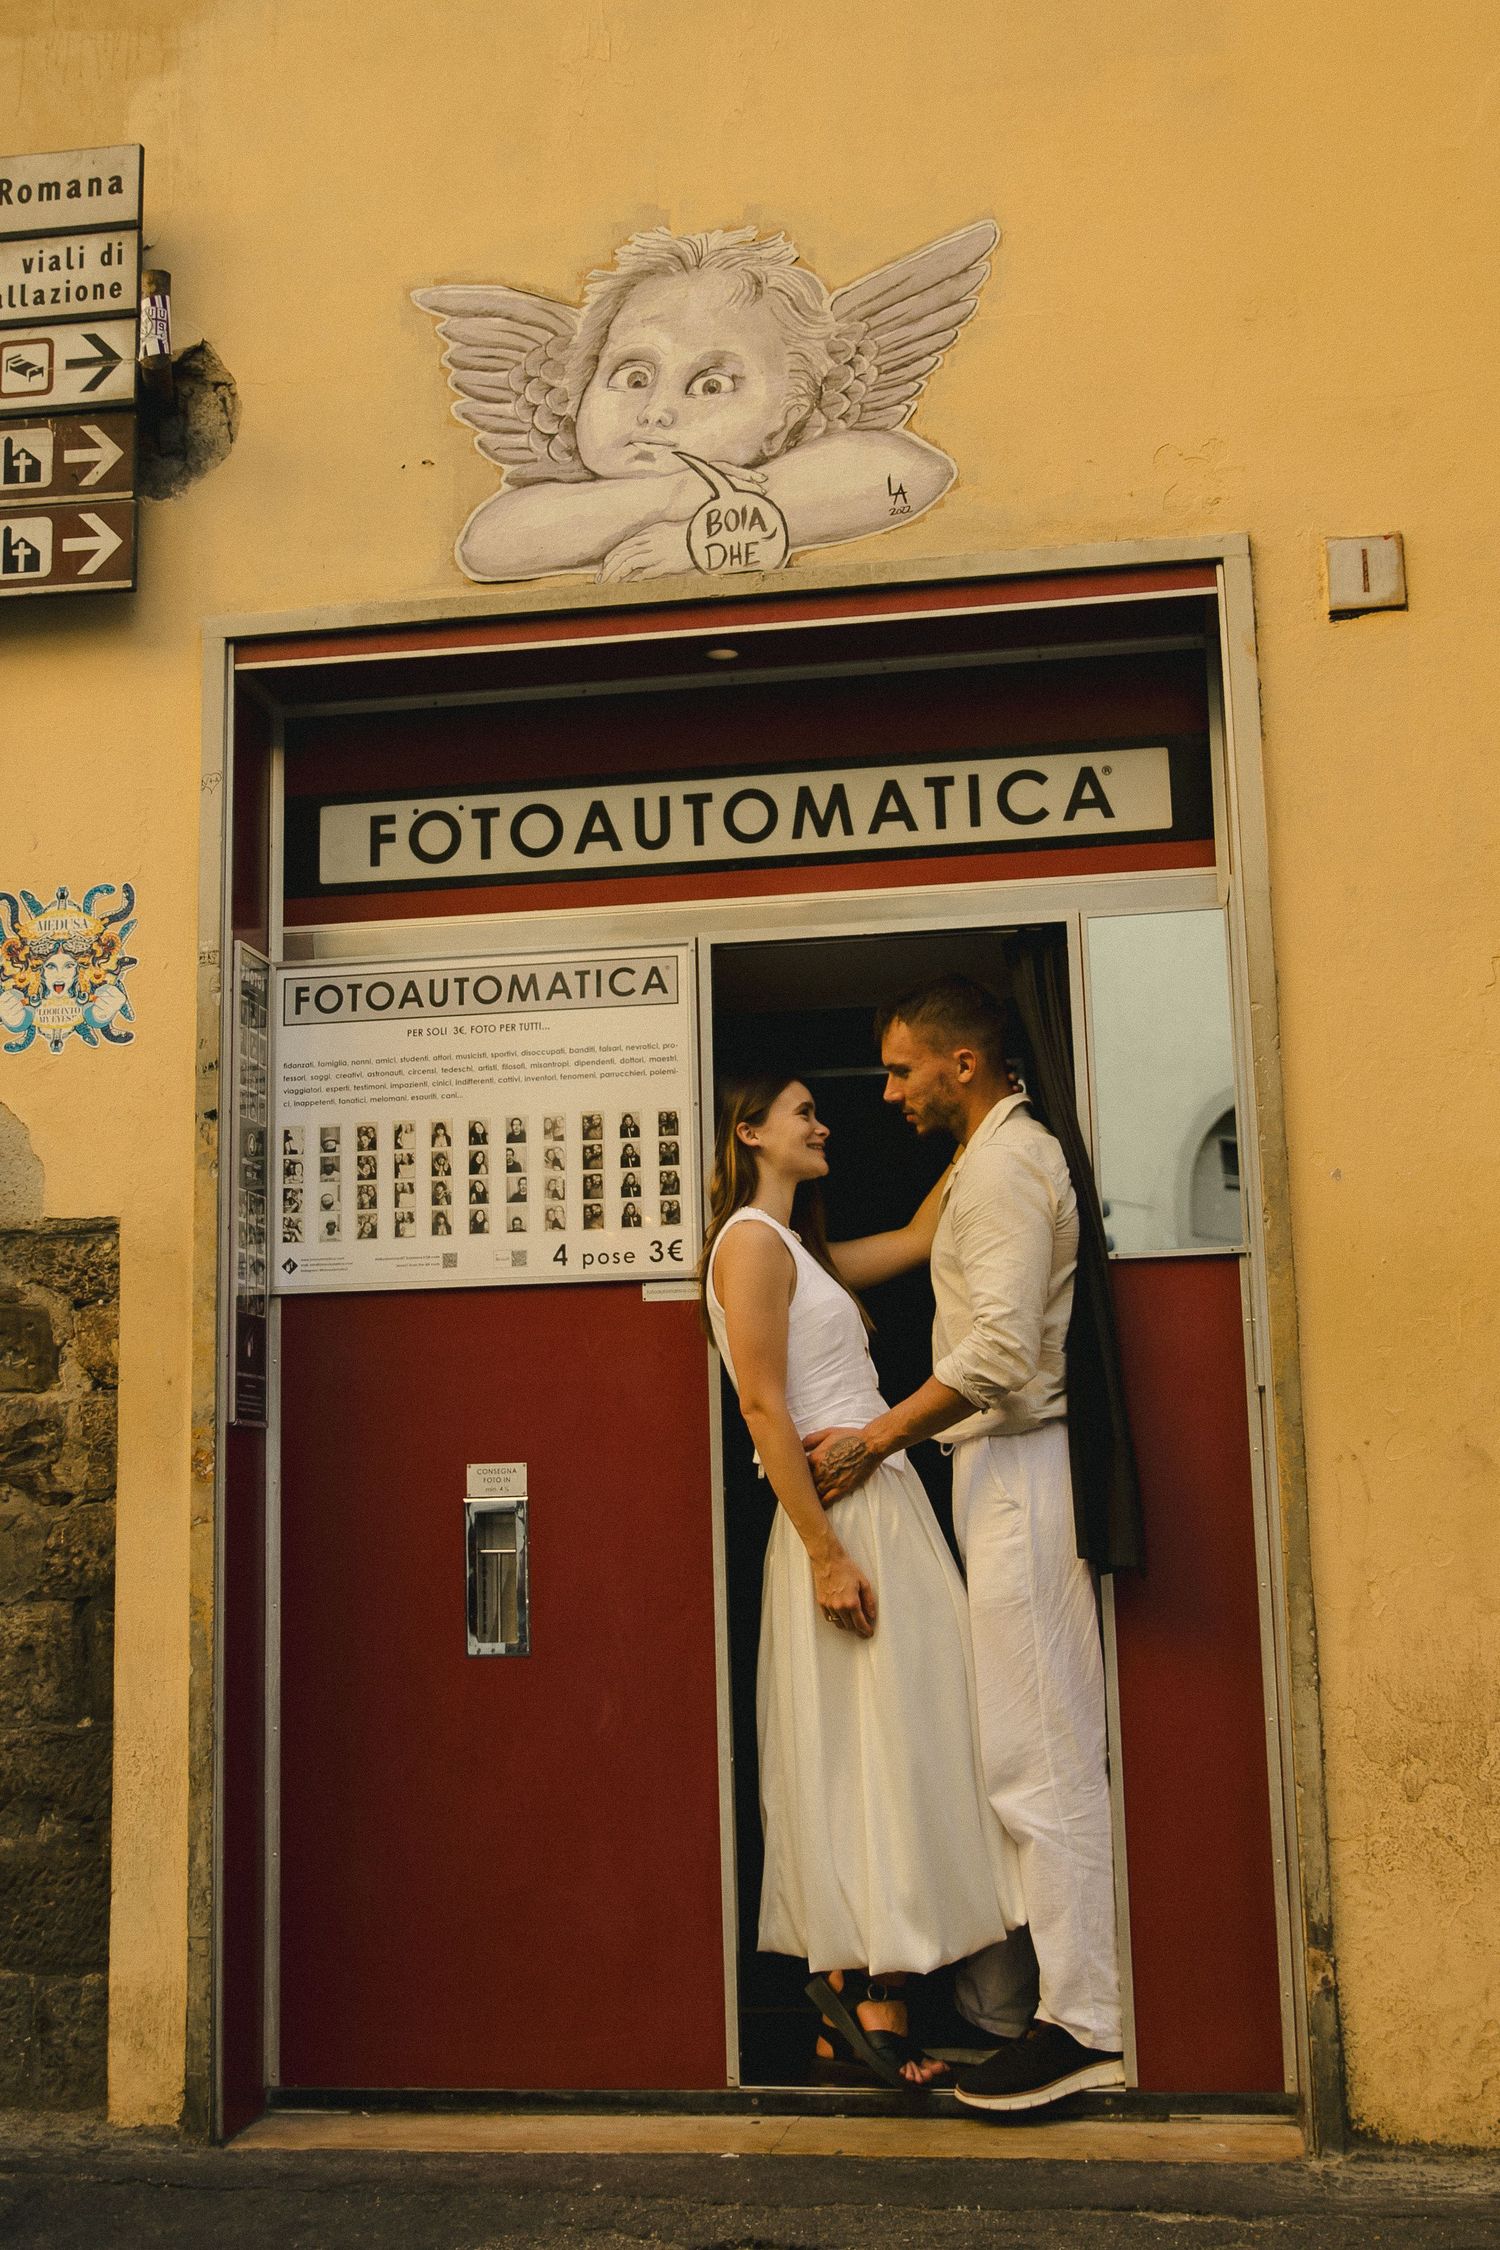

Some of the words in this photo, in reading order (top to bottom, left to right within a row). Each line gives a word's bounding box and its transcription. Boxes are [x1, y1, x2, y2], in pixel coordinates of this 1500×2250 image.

[0, 175, 123, 205] Romana
[22, 246, 84, 274] viali
[100, 242, 122, 267] di
[0, 280, 122, 308] llazione
[888, 505, 913, 516] 2022
[704, 541, 760, 571] DHE
[37, 918, 89, 932] MEDUSA
[408, 1029, 423, 1037] PER
[426, 1027, 448, 1036] SOLI
[470, 1024, 496, 1034] FOTO
[500, 1023, 516, 1032] PER
[520, 1022, 550, 1031] TUTTI...
[400, 1055, 430, 1063] studenti,
[552, 1244, 568, 1266] 4
[582, 1251, 636, 1269] pose
[650, 1239, 684, 1262] 3€
